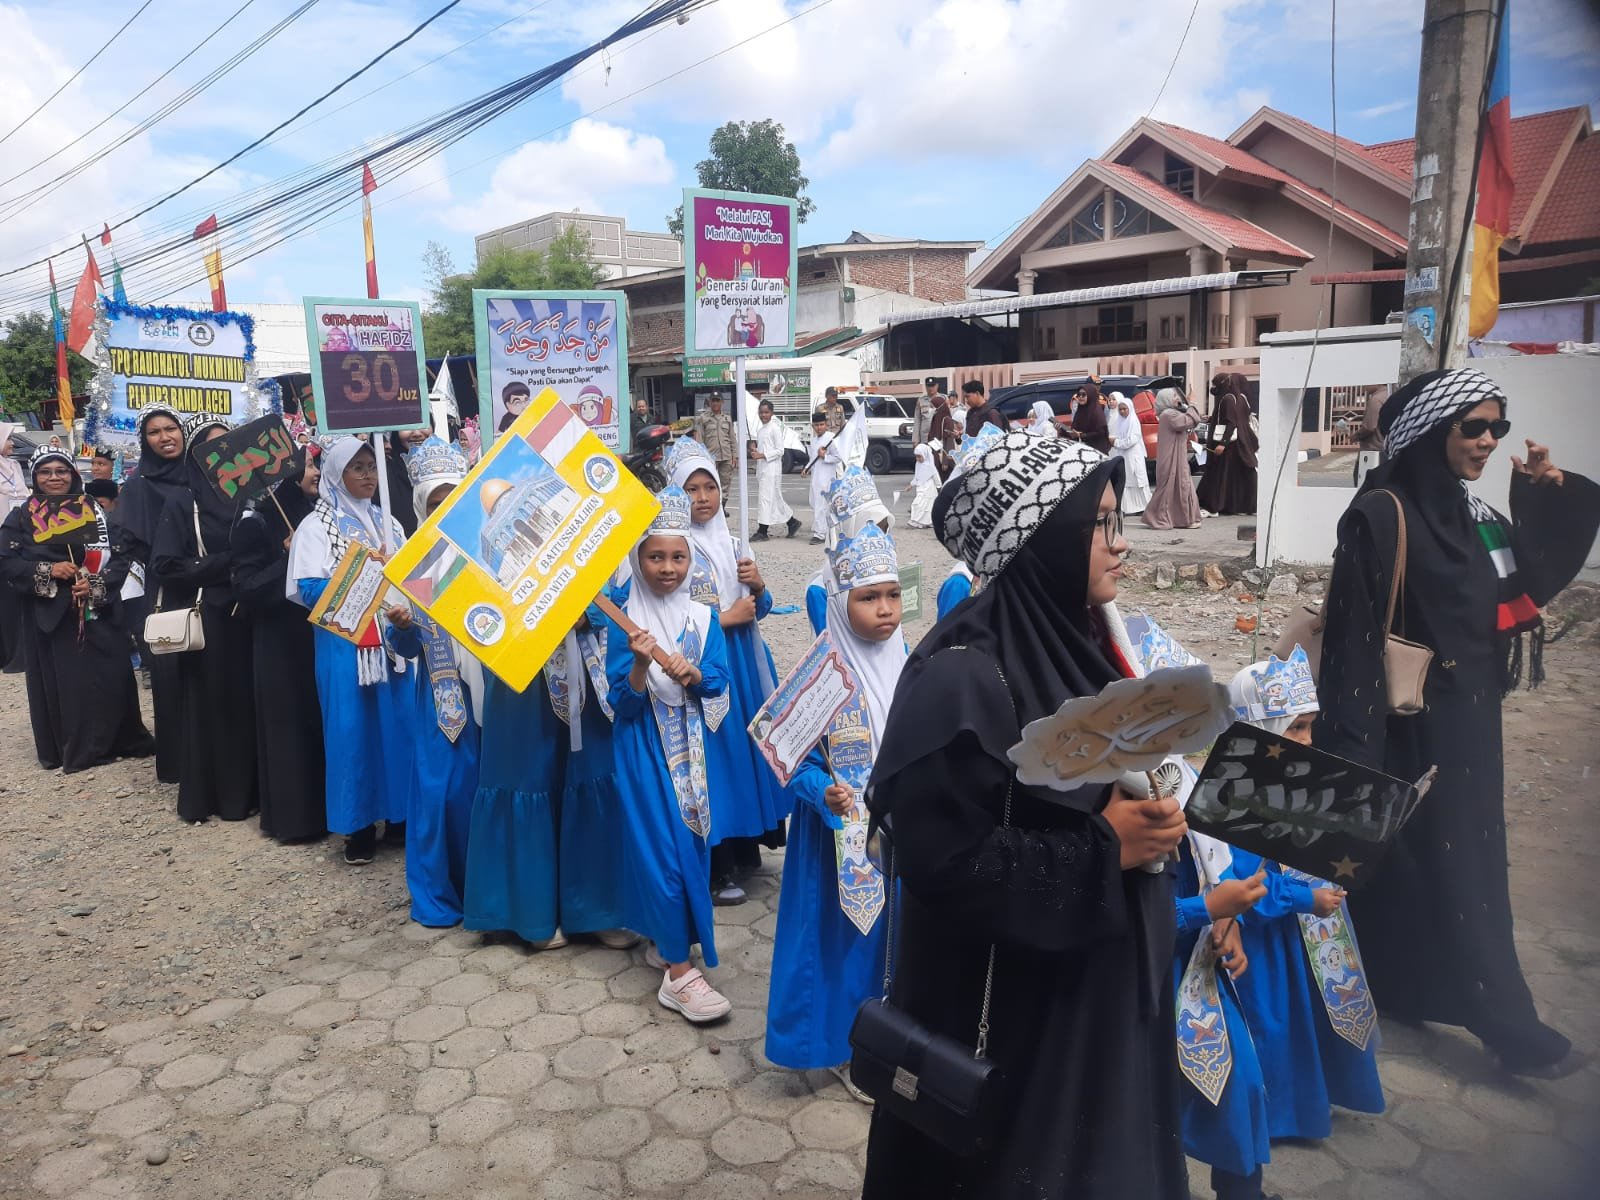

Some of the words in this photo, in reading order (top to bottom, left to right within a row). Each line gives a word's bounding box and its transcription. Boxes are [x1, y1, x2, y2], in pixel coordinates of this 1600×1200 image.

[705, 227, 723, 240] Mari
[724, 228, 741, 242] Kita
[742, 229, 783, 246] Wujudkan
[706, 279, 748, 291] Generasi
[751, 279, 783, 292] Qur'ani
[700, 297, 719, 309] yang
[721, 295, 760, 308] Bersyariat
[360, 331, 412, 347] HAFIDZ
[110, 349, 131, 377] TPQ
[132, 350, 191, 377] RAUDHATUL
[192, 355, 245, 381] MUKMININ
[529, 368, 546, 377] yang
[342, 353, 399, 402] 30
[527, 378, 544, 386] Pasti
[128, 384, 146, 409] PLN
[171, 386, 204, 412] BANDA
[206, 389, 230, 414] ACEH
[397, 387, 418, 401] Juz
[514, 579, 535, 600] TPQ
[541, 496, 600, 569] BAITUSSHALIHIN
[525, 592, 553, 625] STAND
[551, 568, 572, 593] WITH
[575, 513, 618, 562] PALESTINE
